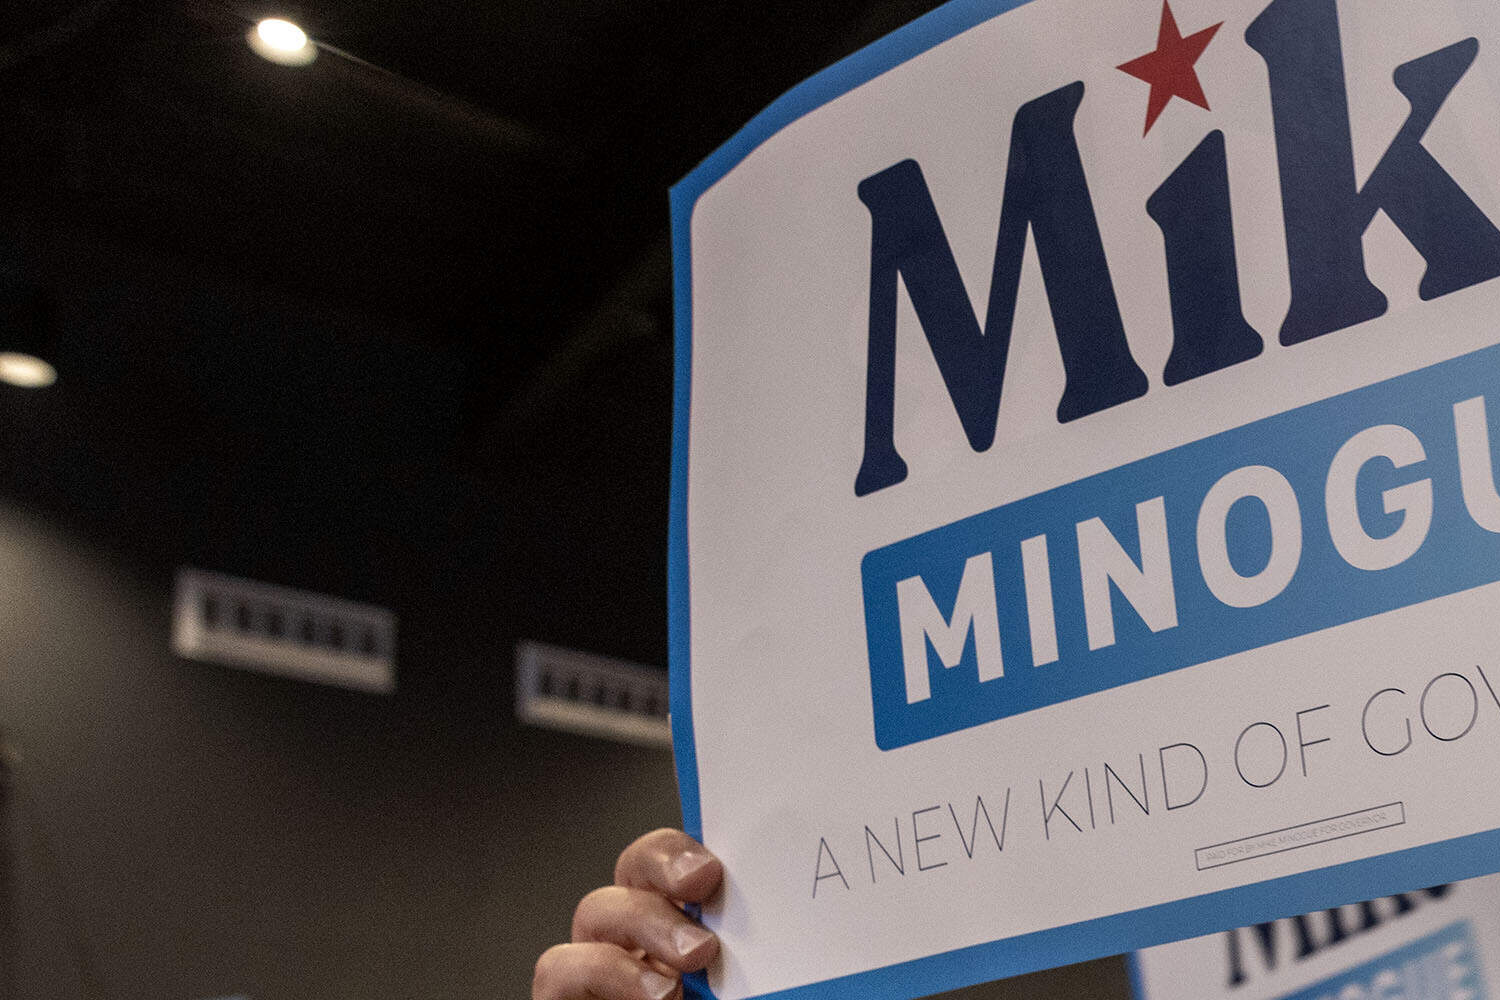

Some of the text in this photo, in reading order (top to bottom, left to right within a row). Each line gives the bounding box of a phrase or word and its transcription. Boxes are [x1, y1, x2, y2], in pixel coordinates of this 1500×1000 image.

[812, 837, 850, 899] A
[864, 787, 1010, 884] NEW
[1039, 742, 1208, 840] KIND
[1233, 703, 1331, 788] OF
